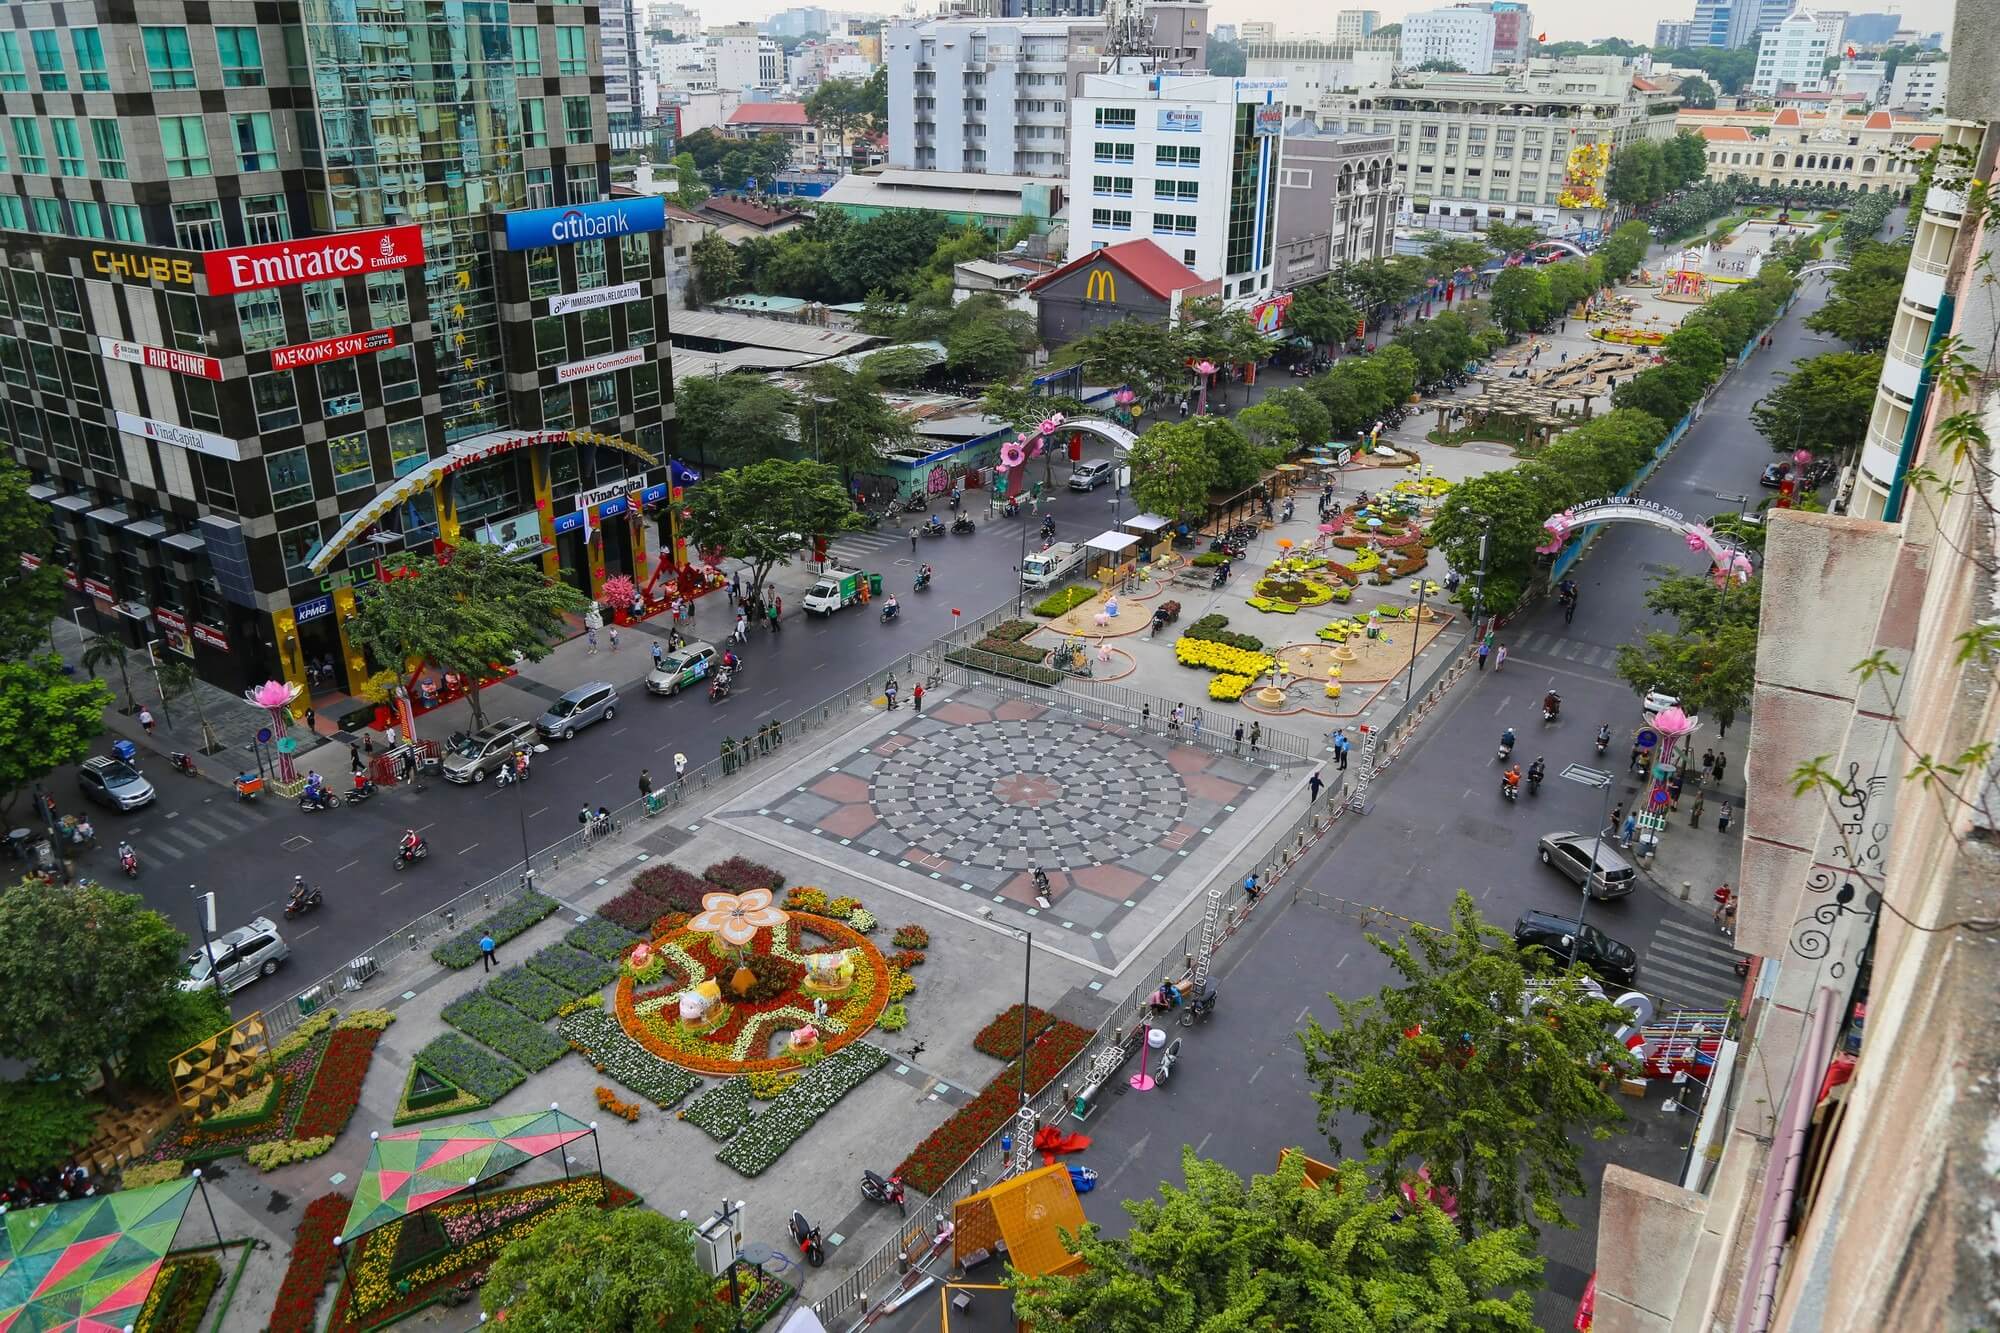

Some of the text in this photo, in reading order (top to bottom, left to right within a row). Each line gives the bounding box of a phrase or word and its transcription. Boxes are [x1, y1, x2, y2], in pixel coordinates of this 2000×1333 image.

[552, 208, 629, 240] citibank
[93, 250, 192, 284] CHUBB
[226, 245, 364, 288] Emirates
[371, 254, 408, 267] Emirates
[570, 292, 606, 308] IMMIGRATION
[608, 287, 639, 301] RELOCATION
[364, 338, 393, 348] COFFEE
[366, 334, 389, 342] VIETNAM
[274, 338, 362, 366] MEKONG SUN
[149, 348, 169, 368] AIR
[170, 353, 206, 376] CHINA
[560, 364, 595, 378] SUNWAH
[153, 423, 205, 448] VinaCapital
[648, 490, 660, 501] citi
[606, 505, 618, 515] citi
[1569, 496, 1684, 520] HAPPY NEW YEAR 2019
[562, 519, 575, 529] citi
[515, 534, 540, 548] TOWER
[299, 604, 327, 621] KPMG
